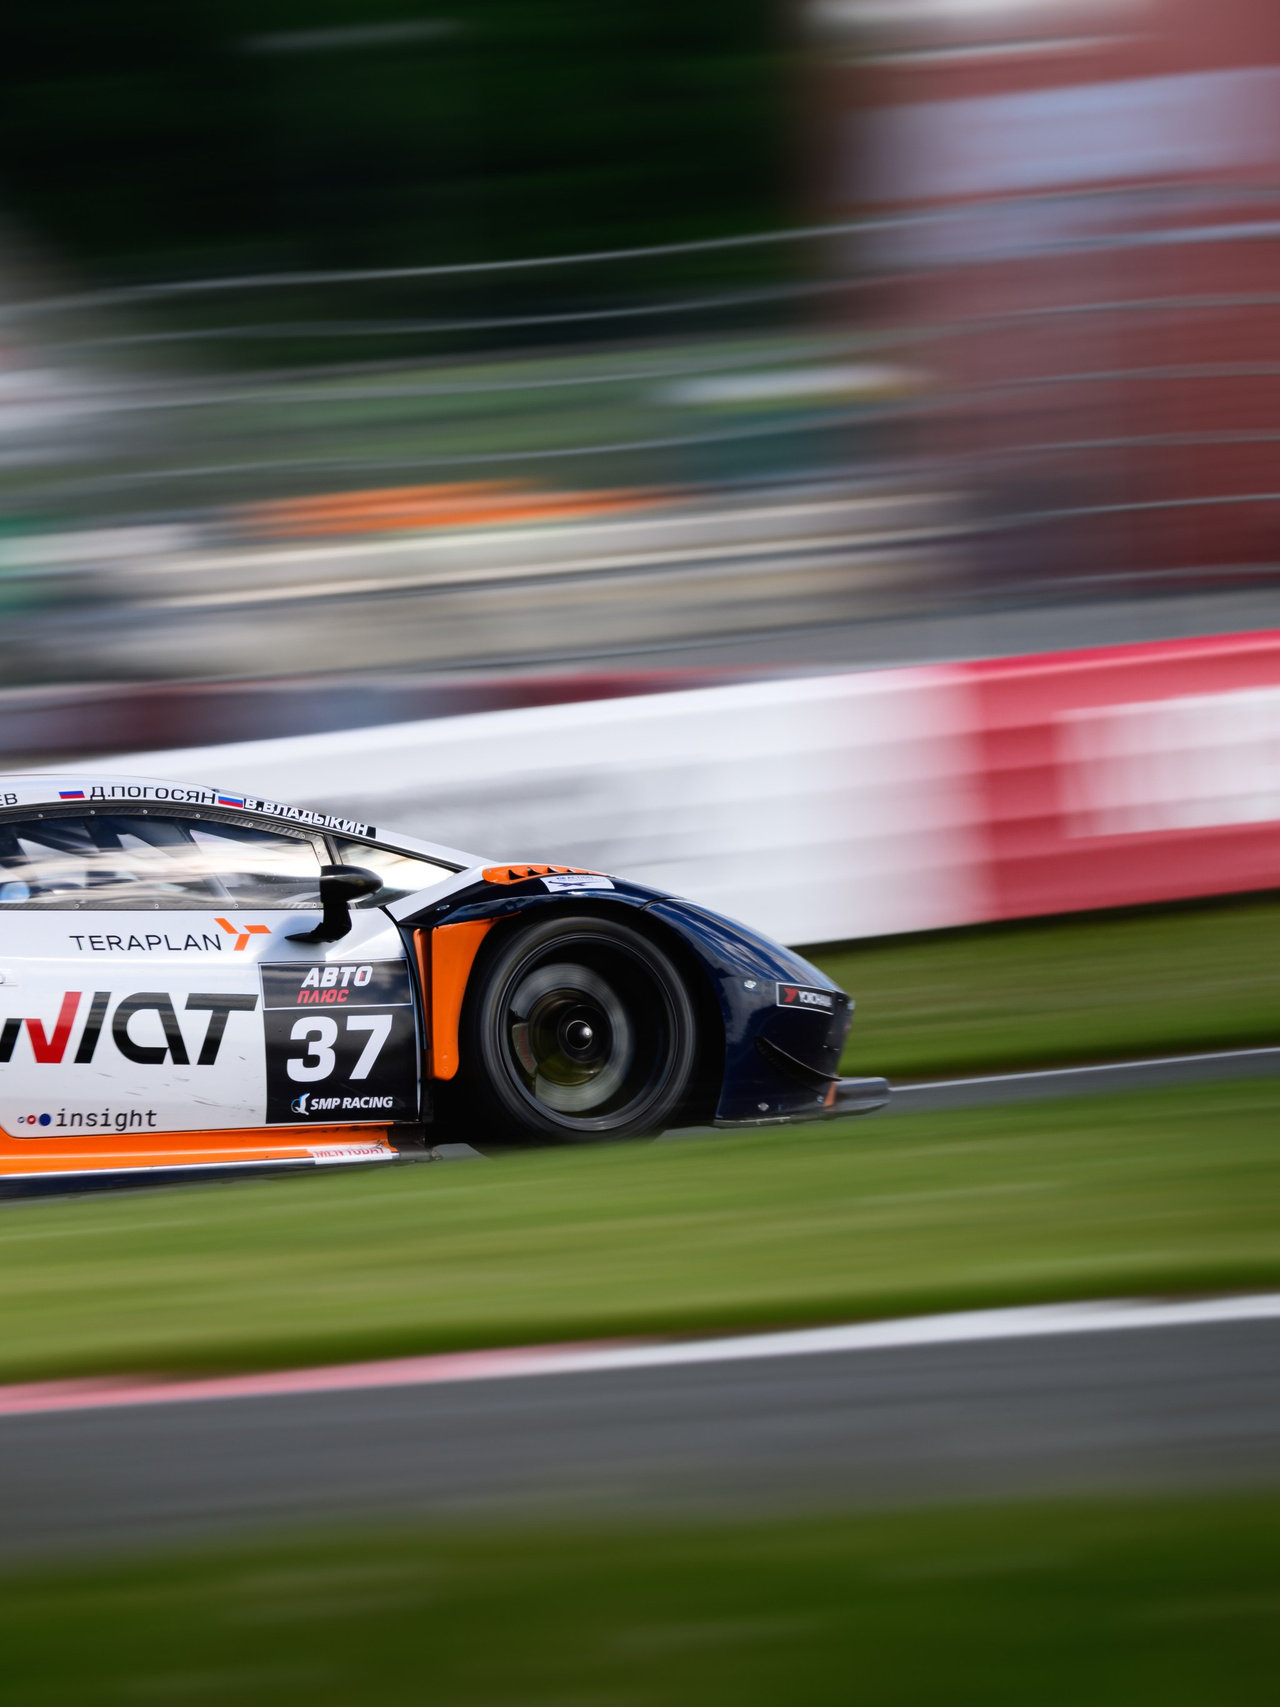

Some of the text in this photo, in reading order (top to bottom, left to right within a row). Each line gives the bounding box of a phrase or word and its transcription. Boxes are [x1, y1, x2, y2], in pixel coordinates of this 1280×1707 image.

[89, 786, 217, 805] Д.ПОГОСЯН
[244, 798, 370, 837] В.ВЛАДЫКИН
[69, 934, 222, 951] TERAPLAN
[300, 966, 373, 988] АВТО
[297, 989, 350, 1004] ПЛЮС
[286, 1014, 394, 1083] 37
[310, 1096, 393, 1110] SMP RACING
[55, 1108, 158, 1132] insight
